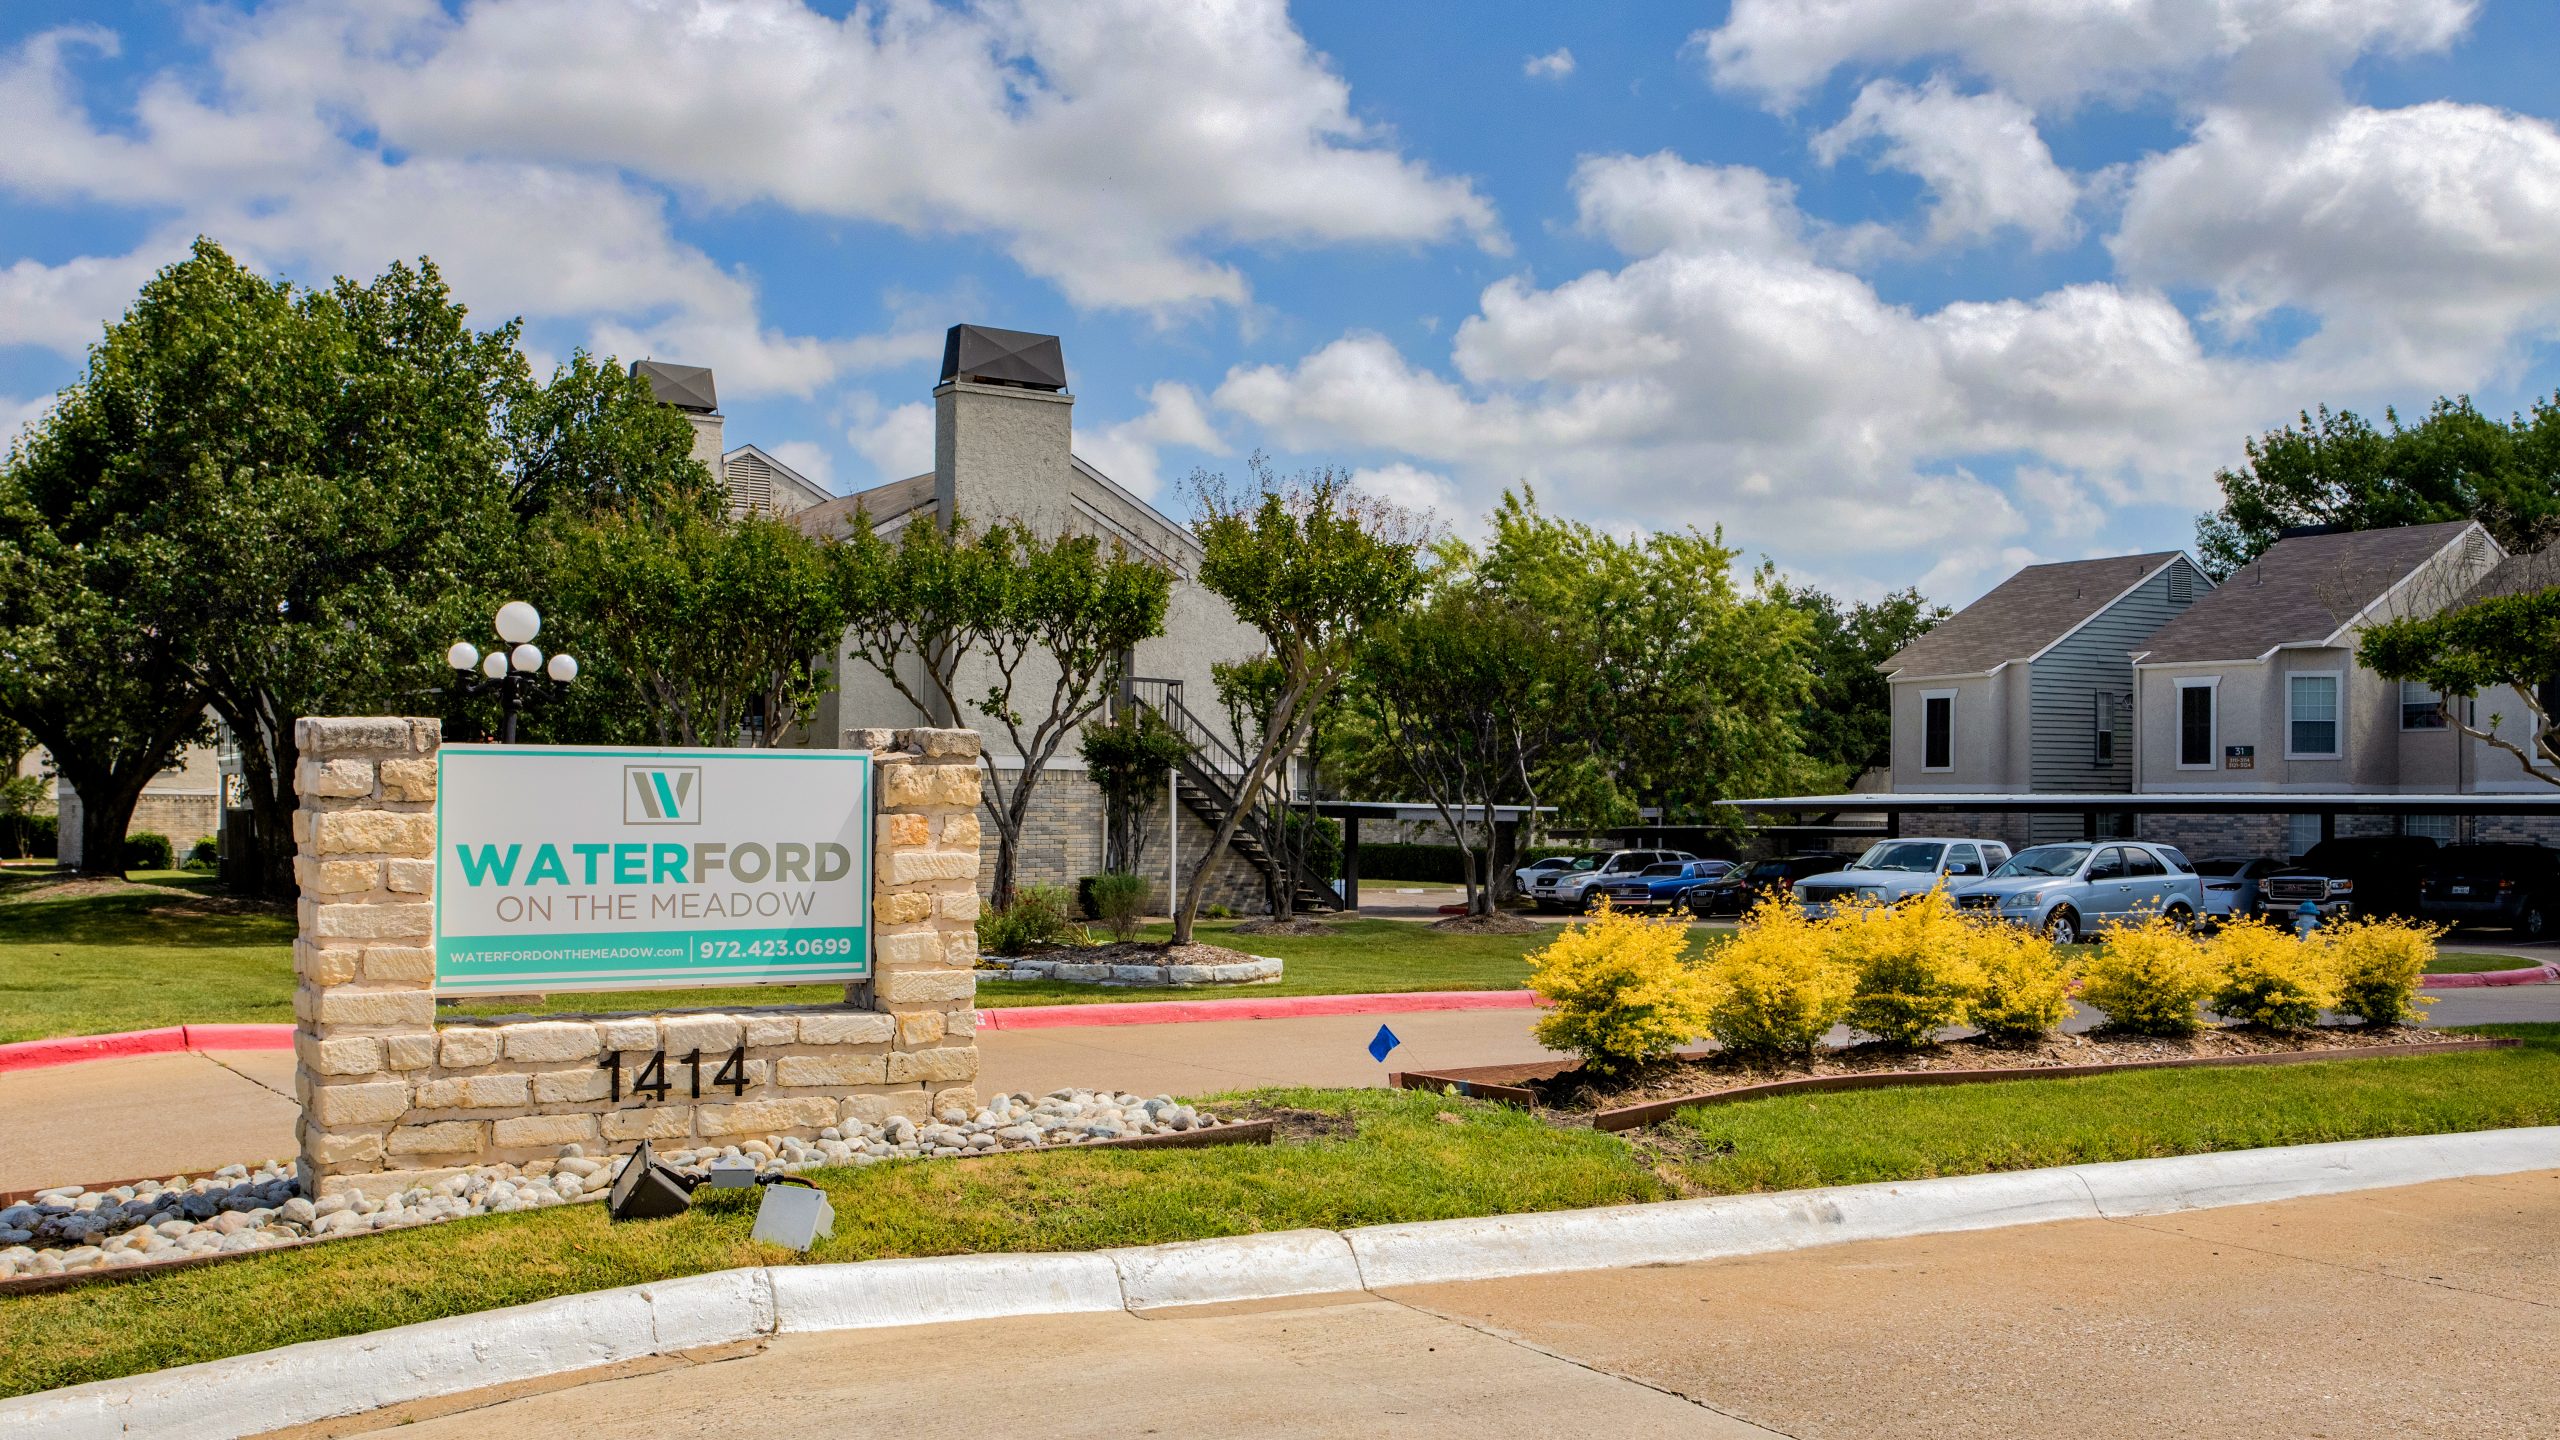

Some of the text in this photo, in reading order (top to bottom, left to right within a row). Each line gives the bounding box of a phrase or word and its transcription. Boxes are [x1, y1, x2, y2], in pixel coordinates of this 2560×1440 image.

[2235, 747, 2244, 756] 31
[455, 841, 851, 887] WATERFORD
[496, 890, 816, 922] ON THE MEADOW
[450, 945, 684, 963] WATERFORDONTHEMEADOW.com
[700, 938, 851, 959] 972.423.0699
[599, 1046, 750, 1102] 1414
